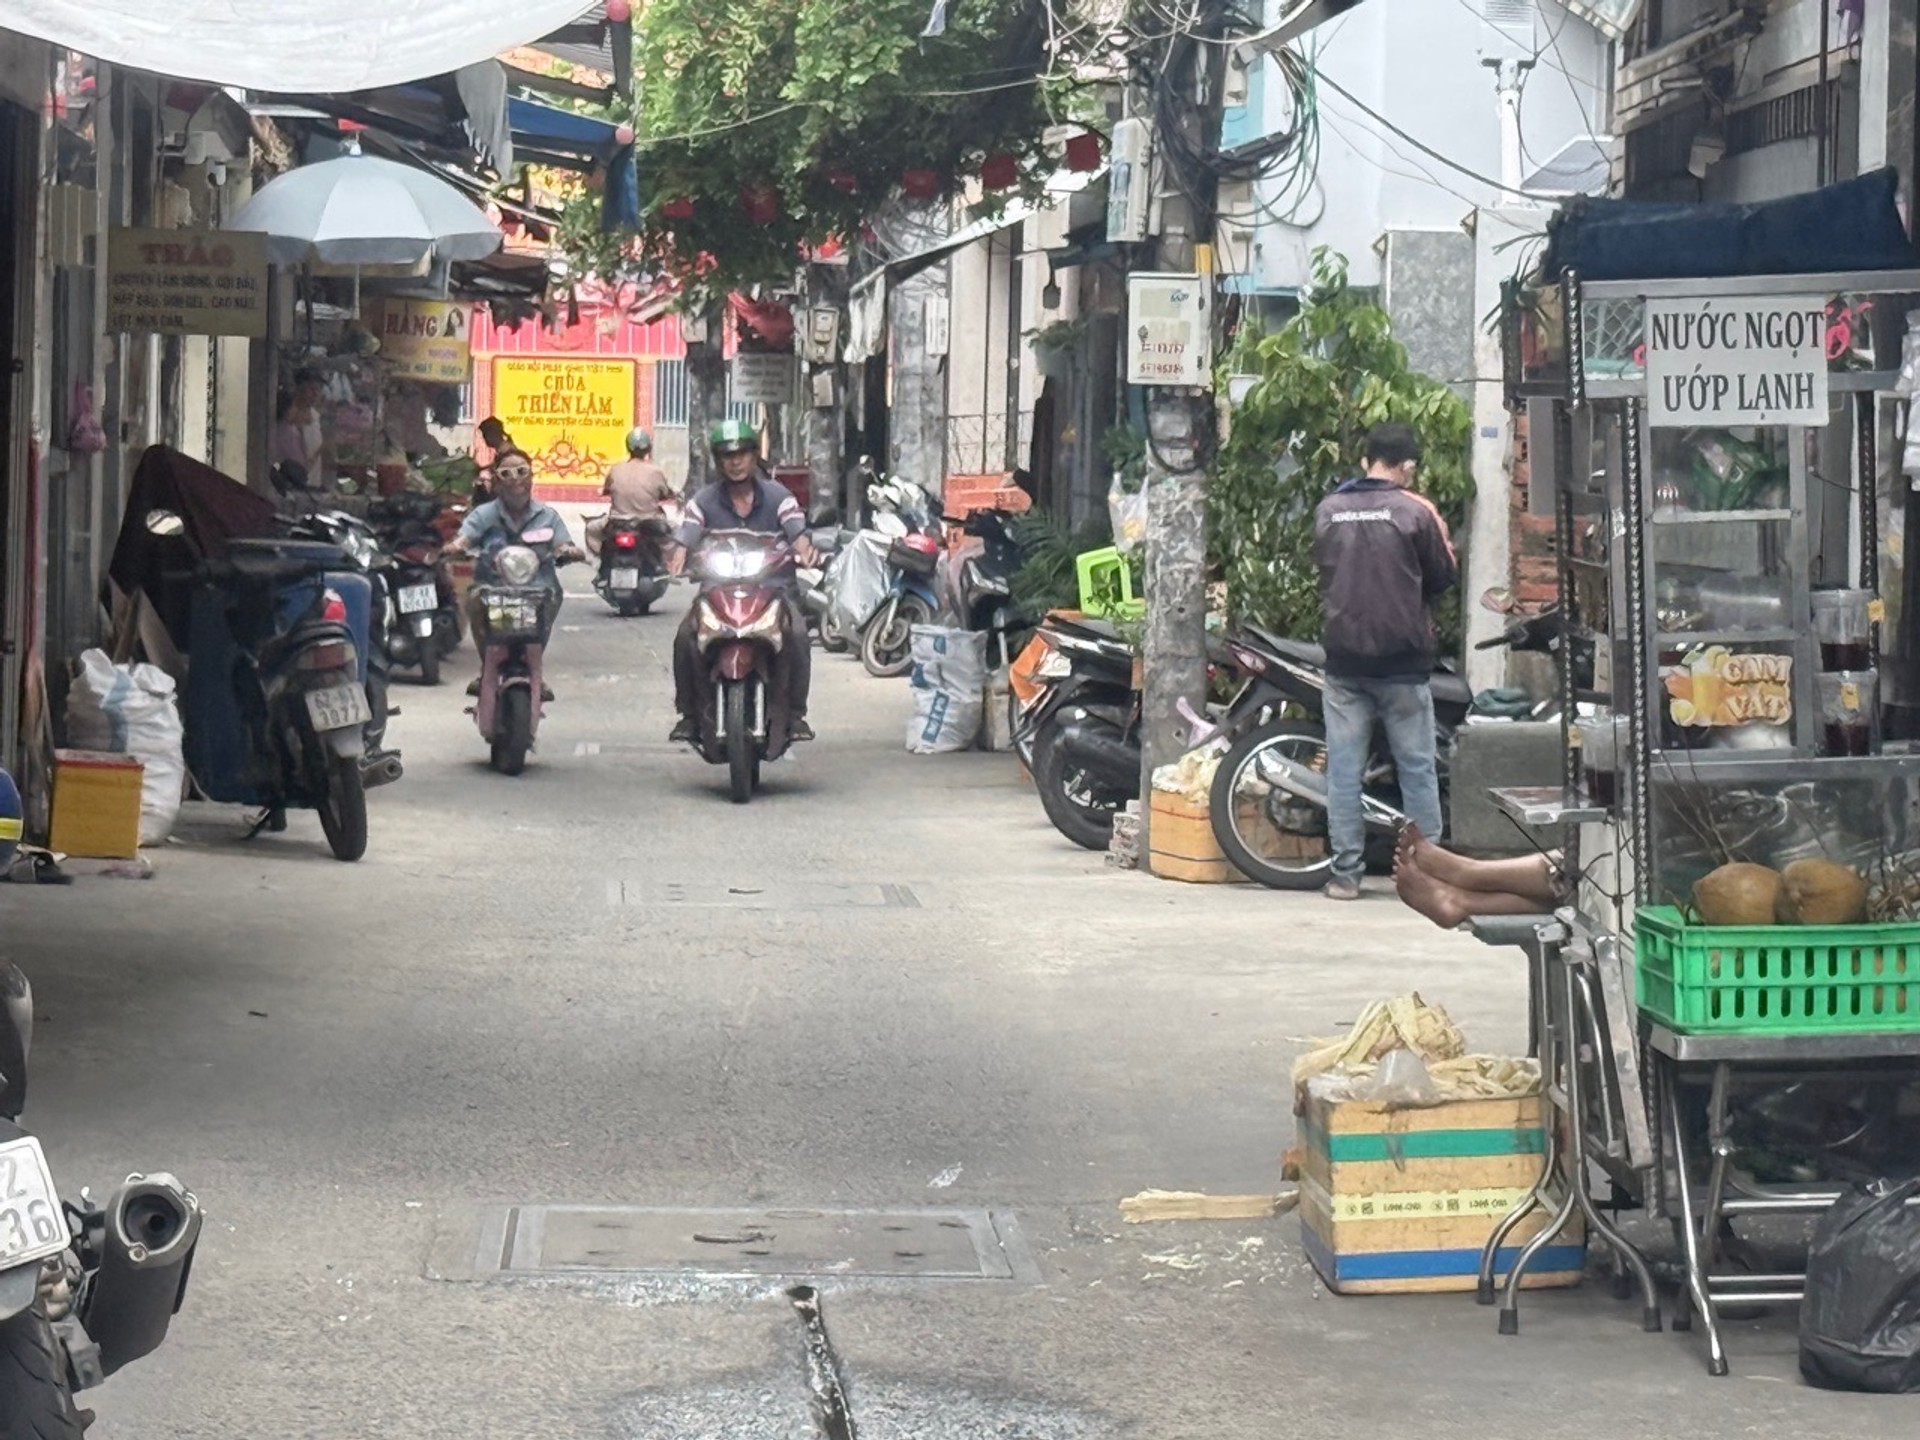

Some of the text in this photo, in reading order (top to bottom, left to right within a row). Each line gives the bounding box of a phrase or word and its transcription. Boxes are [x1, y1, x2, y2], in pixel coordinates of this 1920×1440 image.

[1652, 301, 1824, 358] NƯỚC NGỌT
[1663, 363, 1815, 420] ƯỚP LẠNH
[1721, 656, 1789, 686] CAM
